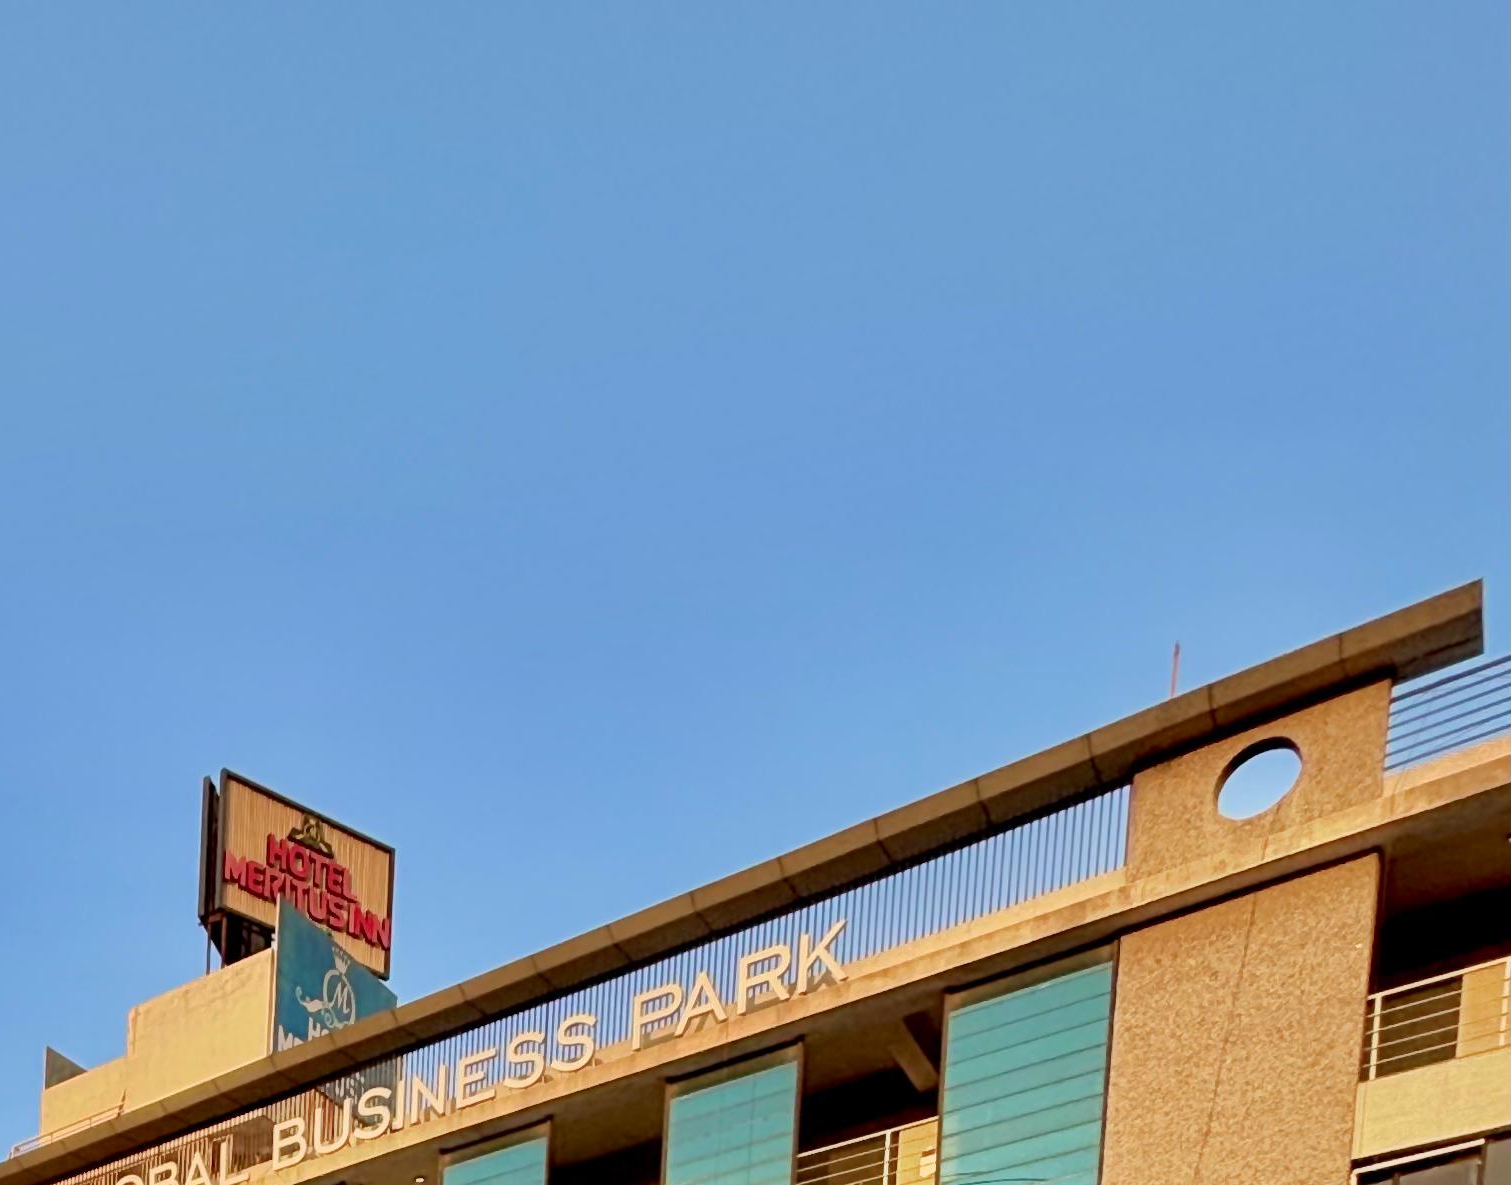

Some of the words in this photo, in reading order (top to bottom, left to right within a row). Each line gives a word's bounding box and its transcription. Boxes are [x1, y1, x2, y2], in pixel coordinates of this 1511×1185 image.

[224, 851, 347, 929] MERITUS
[348, 906, 391, 949] INN
[267, 833, 357, 900] HOTEL
[272, 1013, 597, 1171] BUSINESS
[631, 918, 849, 1052] PARK
